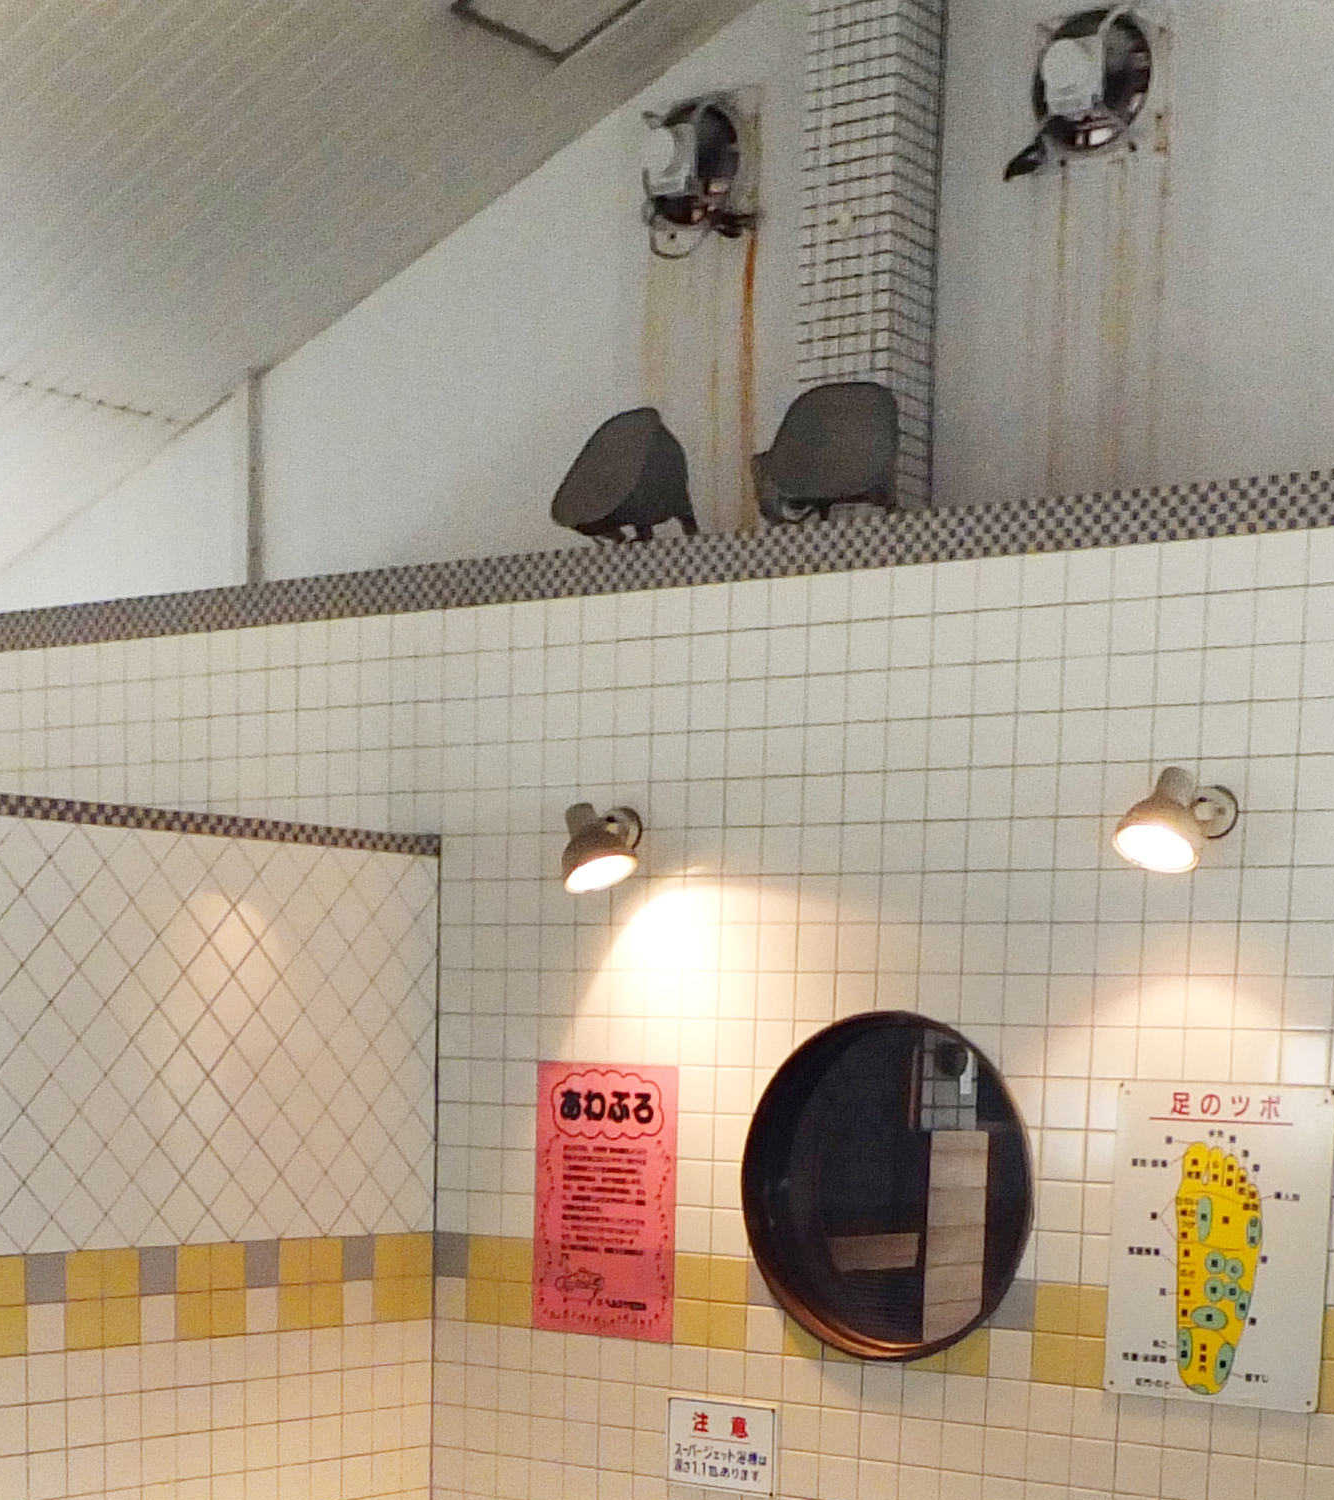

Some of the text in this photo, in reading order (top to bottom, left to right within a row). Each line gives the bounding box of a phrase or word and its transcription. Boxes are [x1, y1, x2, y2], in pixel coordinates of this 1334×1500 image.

[1170, 1091, 1281, 1119] 足のツボ
[692, 1411, 749, 1439] 注意
